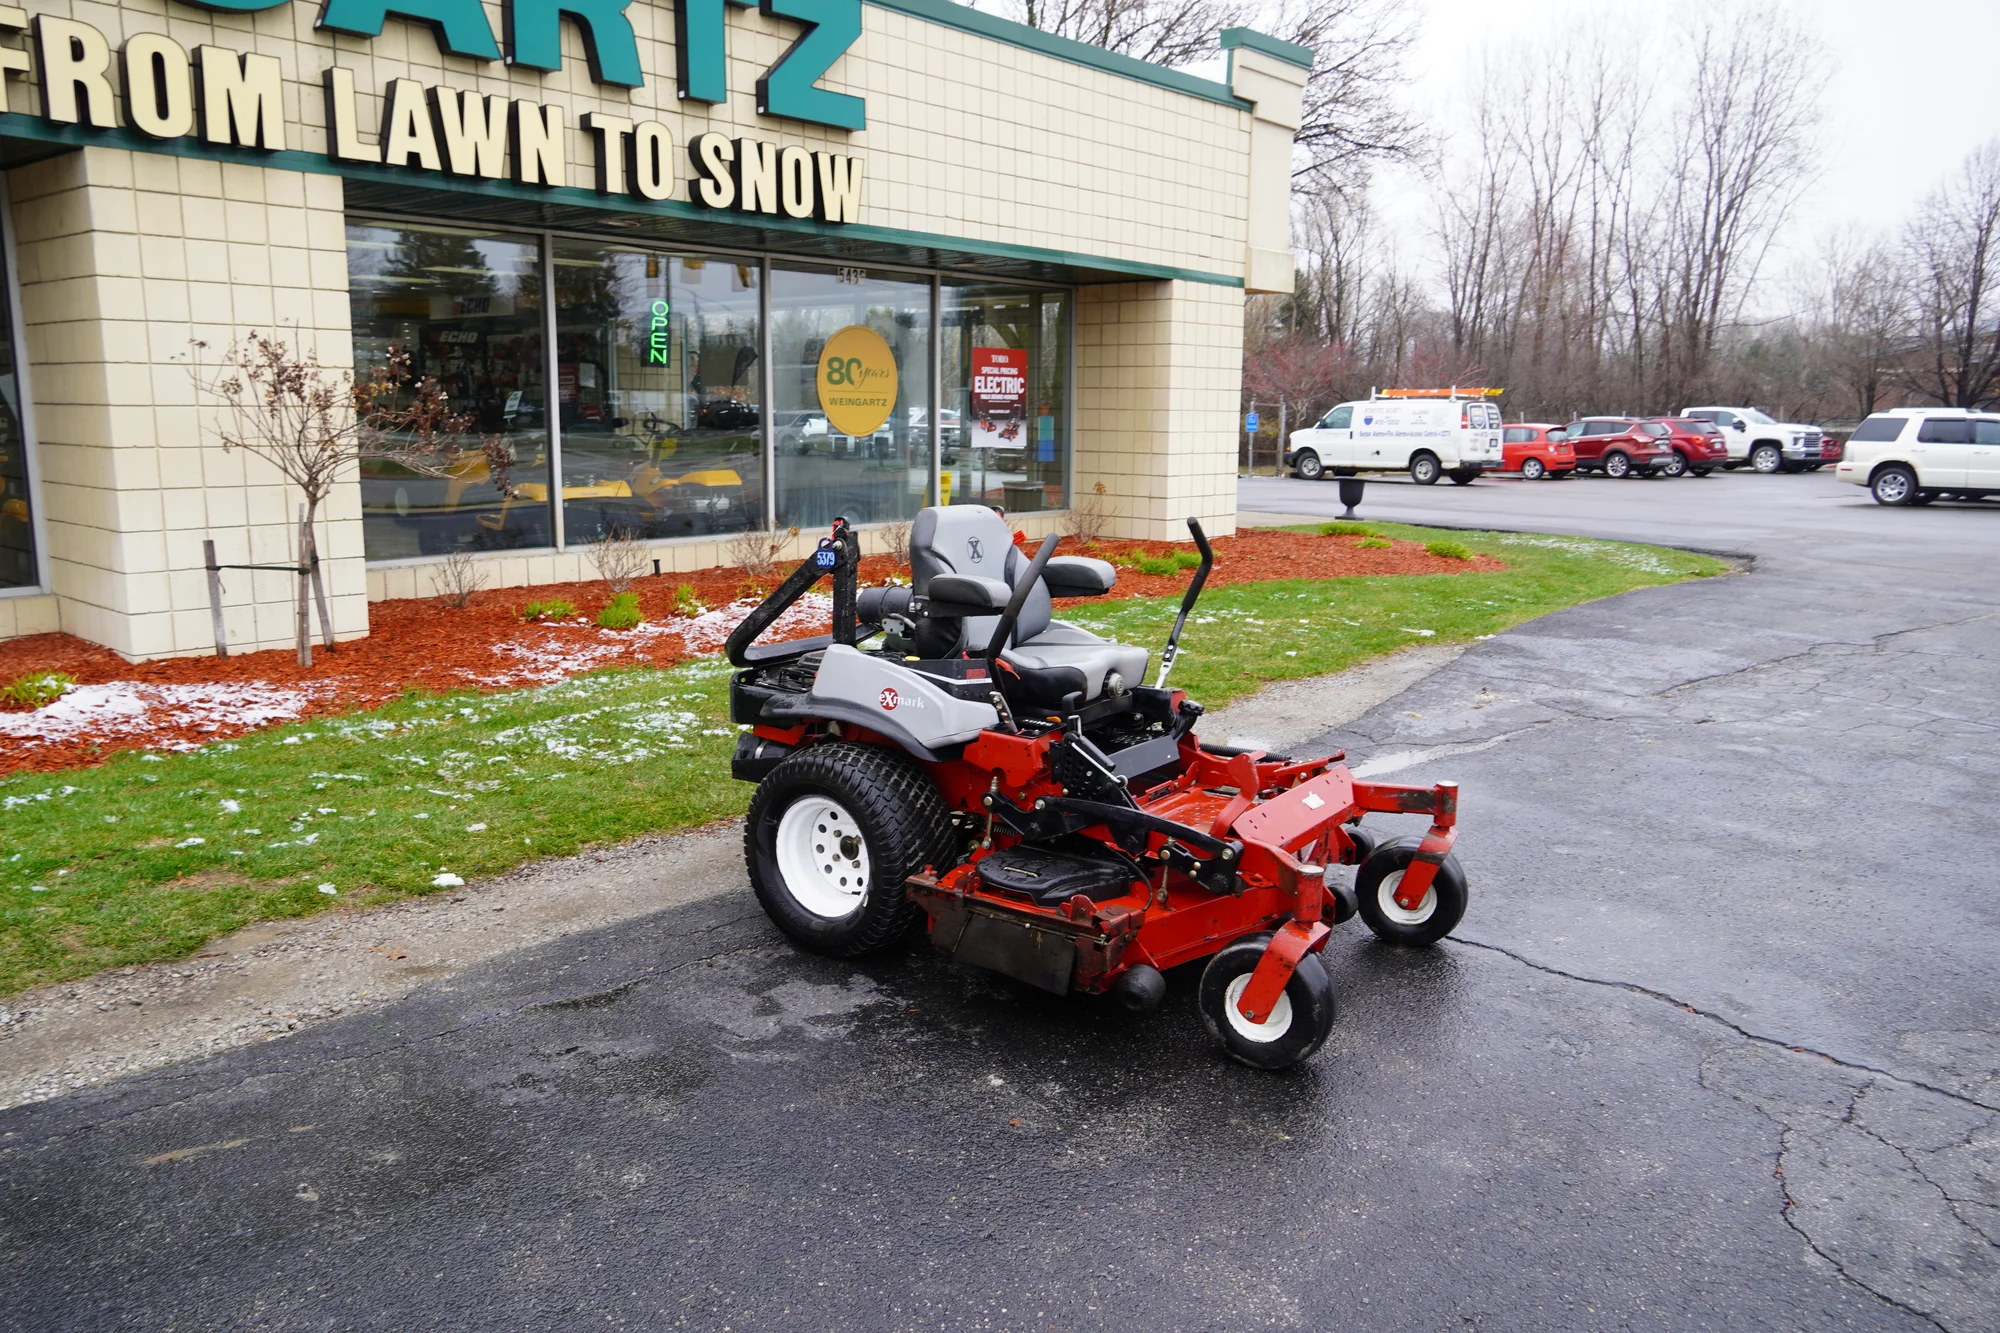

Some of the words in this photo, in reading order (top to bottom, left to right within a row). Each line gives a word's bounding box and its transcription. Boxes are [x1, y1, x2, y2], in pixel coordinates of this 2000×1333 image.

[324, 67, 566, 187] LAWN
[580, 112, 675, 201] TO
[690, 131, 866, 224] SNOW
[439, 331, 478, 344] ECHO
[651, 300, 669, 365] OPEN
[827, 356, 862, 386] 80
[855, 366, 890, 390] years
[974, 375, 1025, 394] ELECTRIC
[828, 397, 888, 407] WEINGARTZ
[817, 551, 835, 566] 5379
